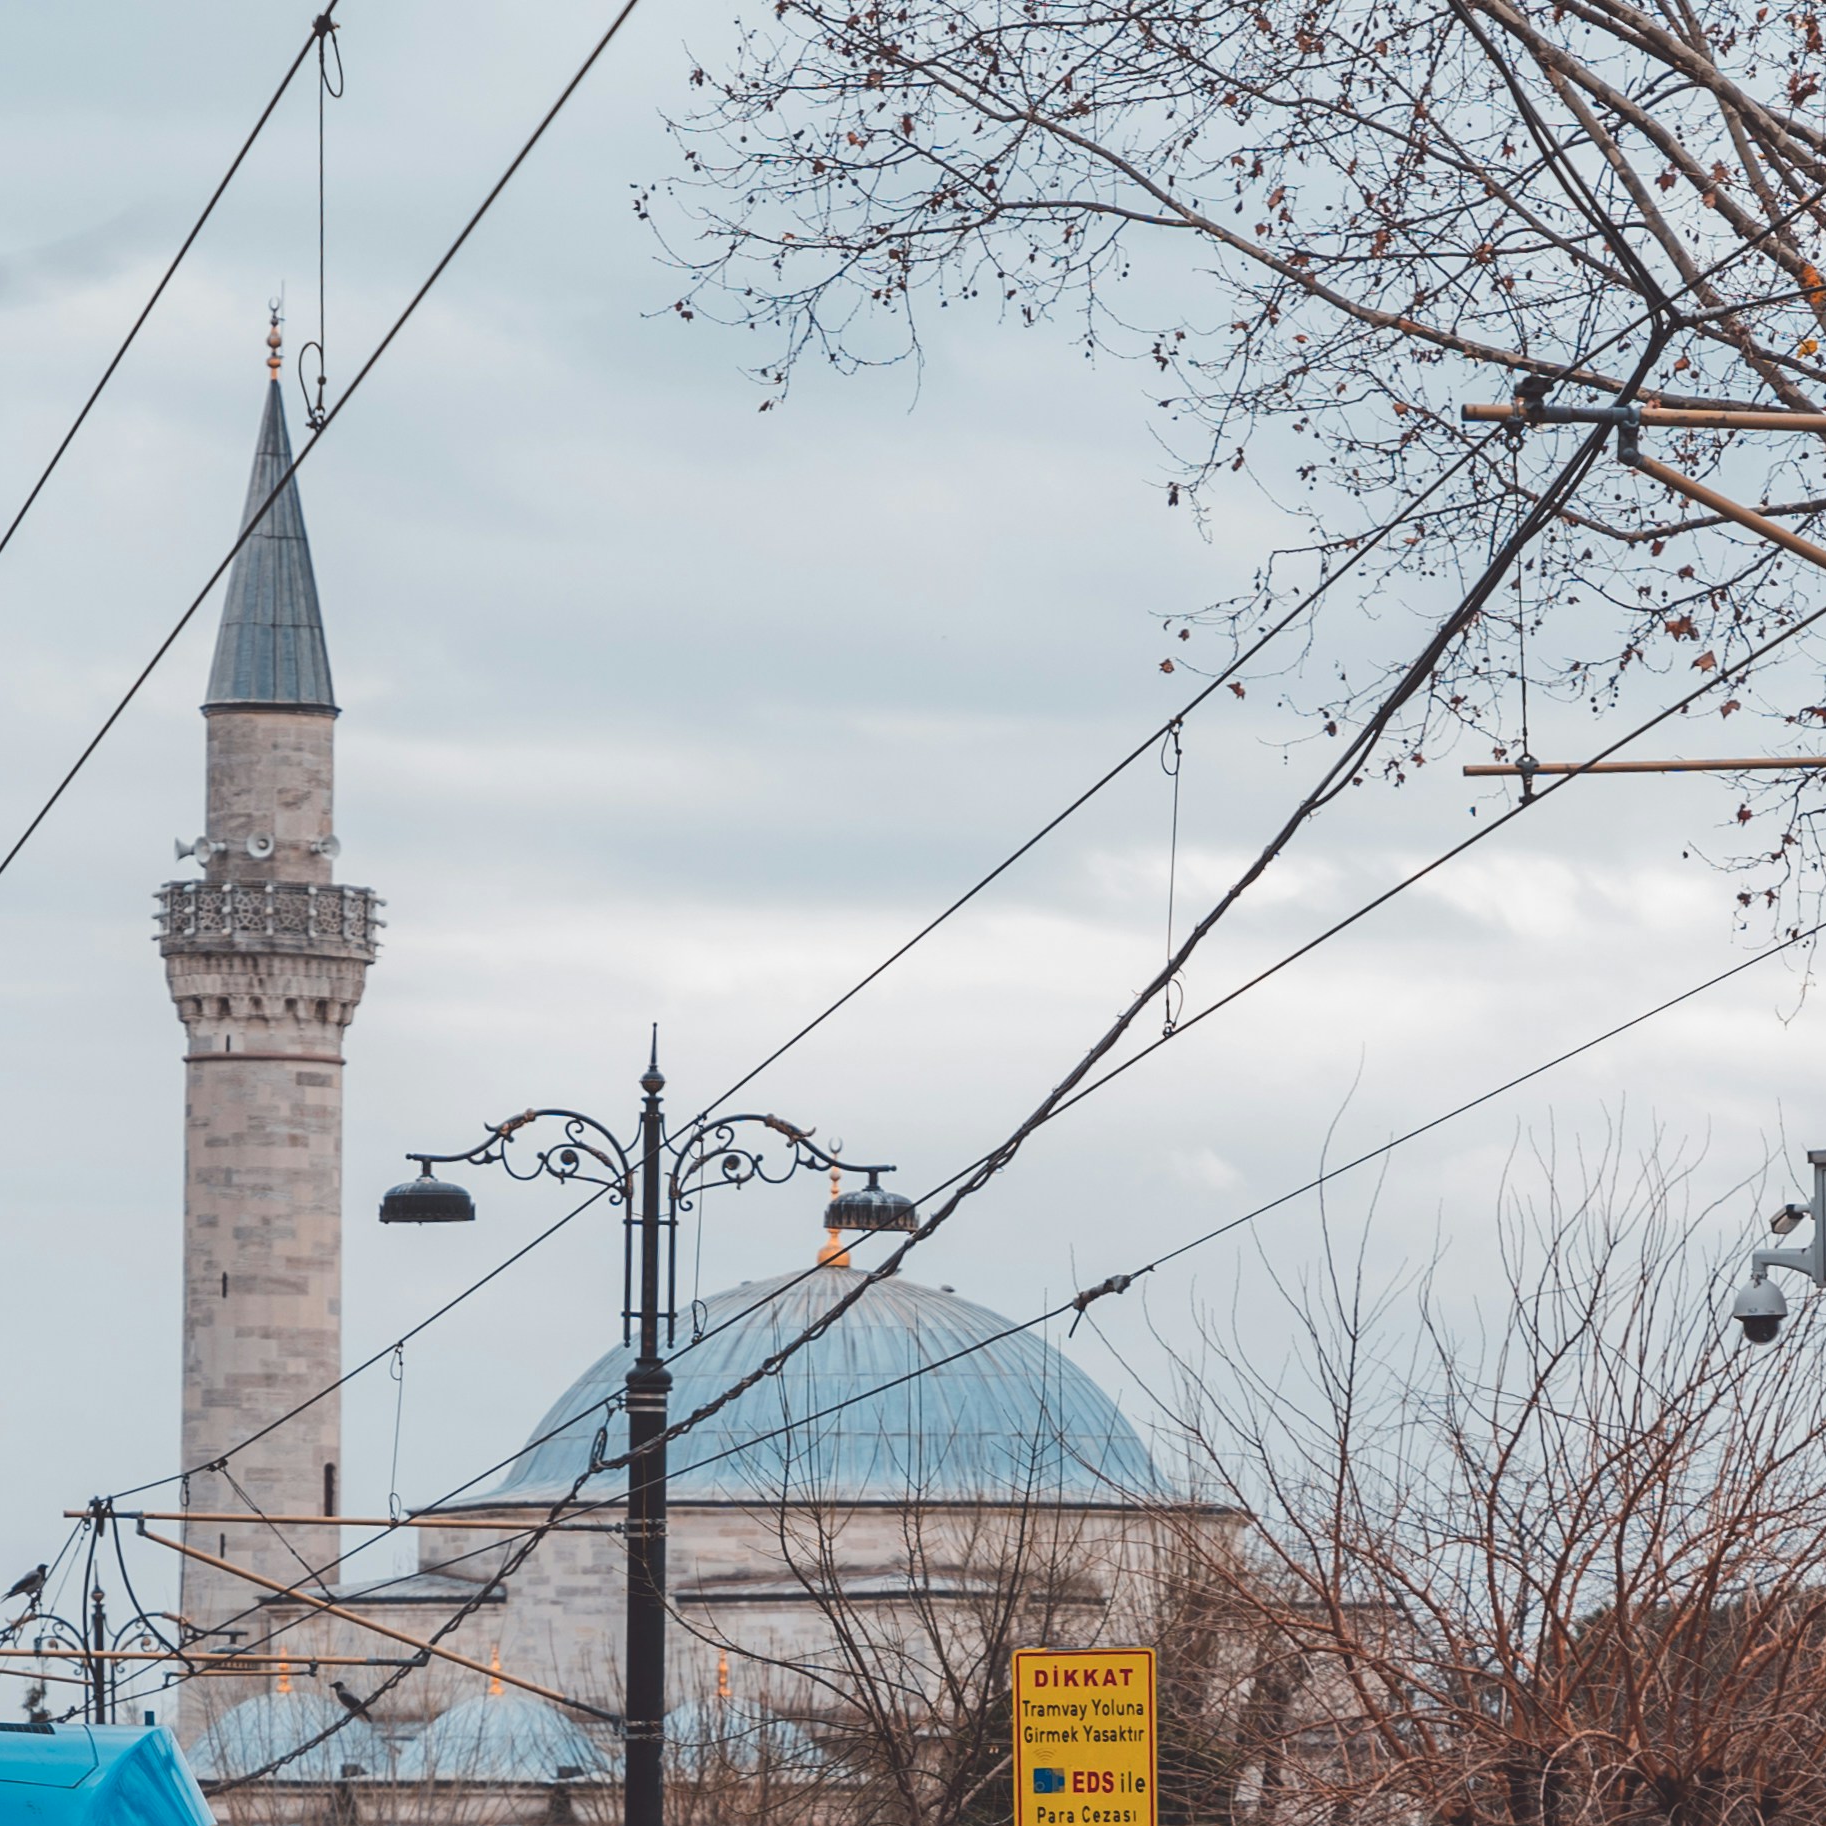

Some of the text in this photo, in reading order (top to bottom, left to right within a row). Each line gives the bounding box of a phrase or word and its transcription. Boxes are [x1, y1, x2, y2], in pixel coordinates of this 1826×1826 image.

[1034, 1665, 1134, 1688] DİKKAT
[1022, 1699, 1144, 1721] Tramvay Yoluna
[1024, 1725, 1145, 1743] Girmek Yasaktır
[1072, 1771, 1146, 1794] EDS ile
[1037, 1806, 1137, 1824] Para Cezası
